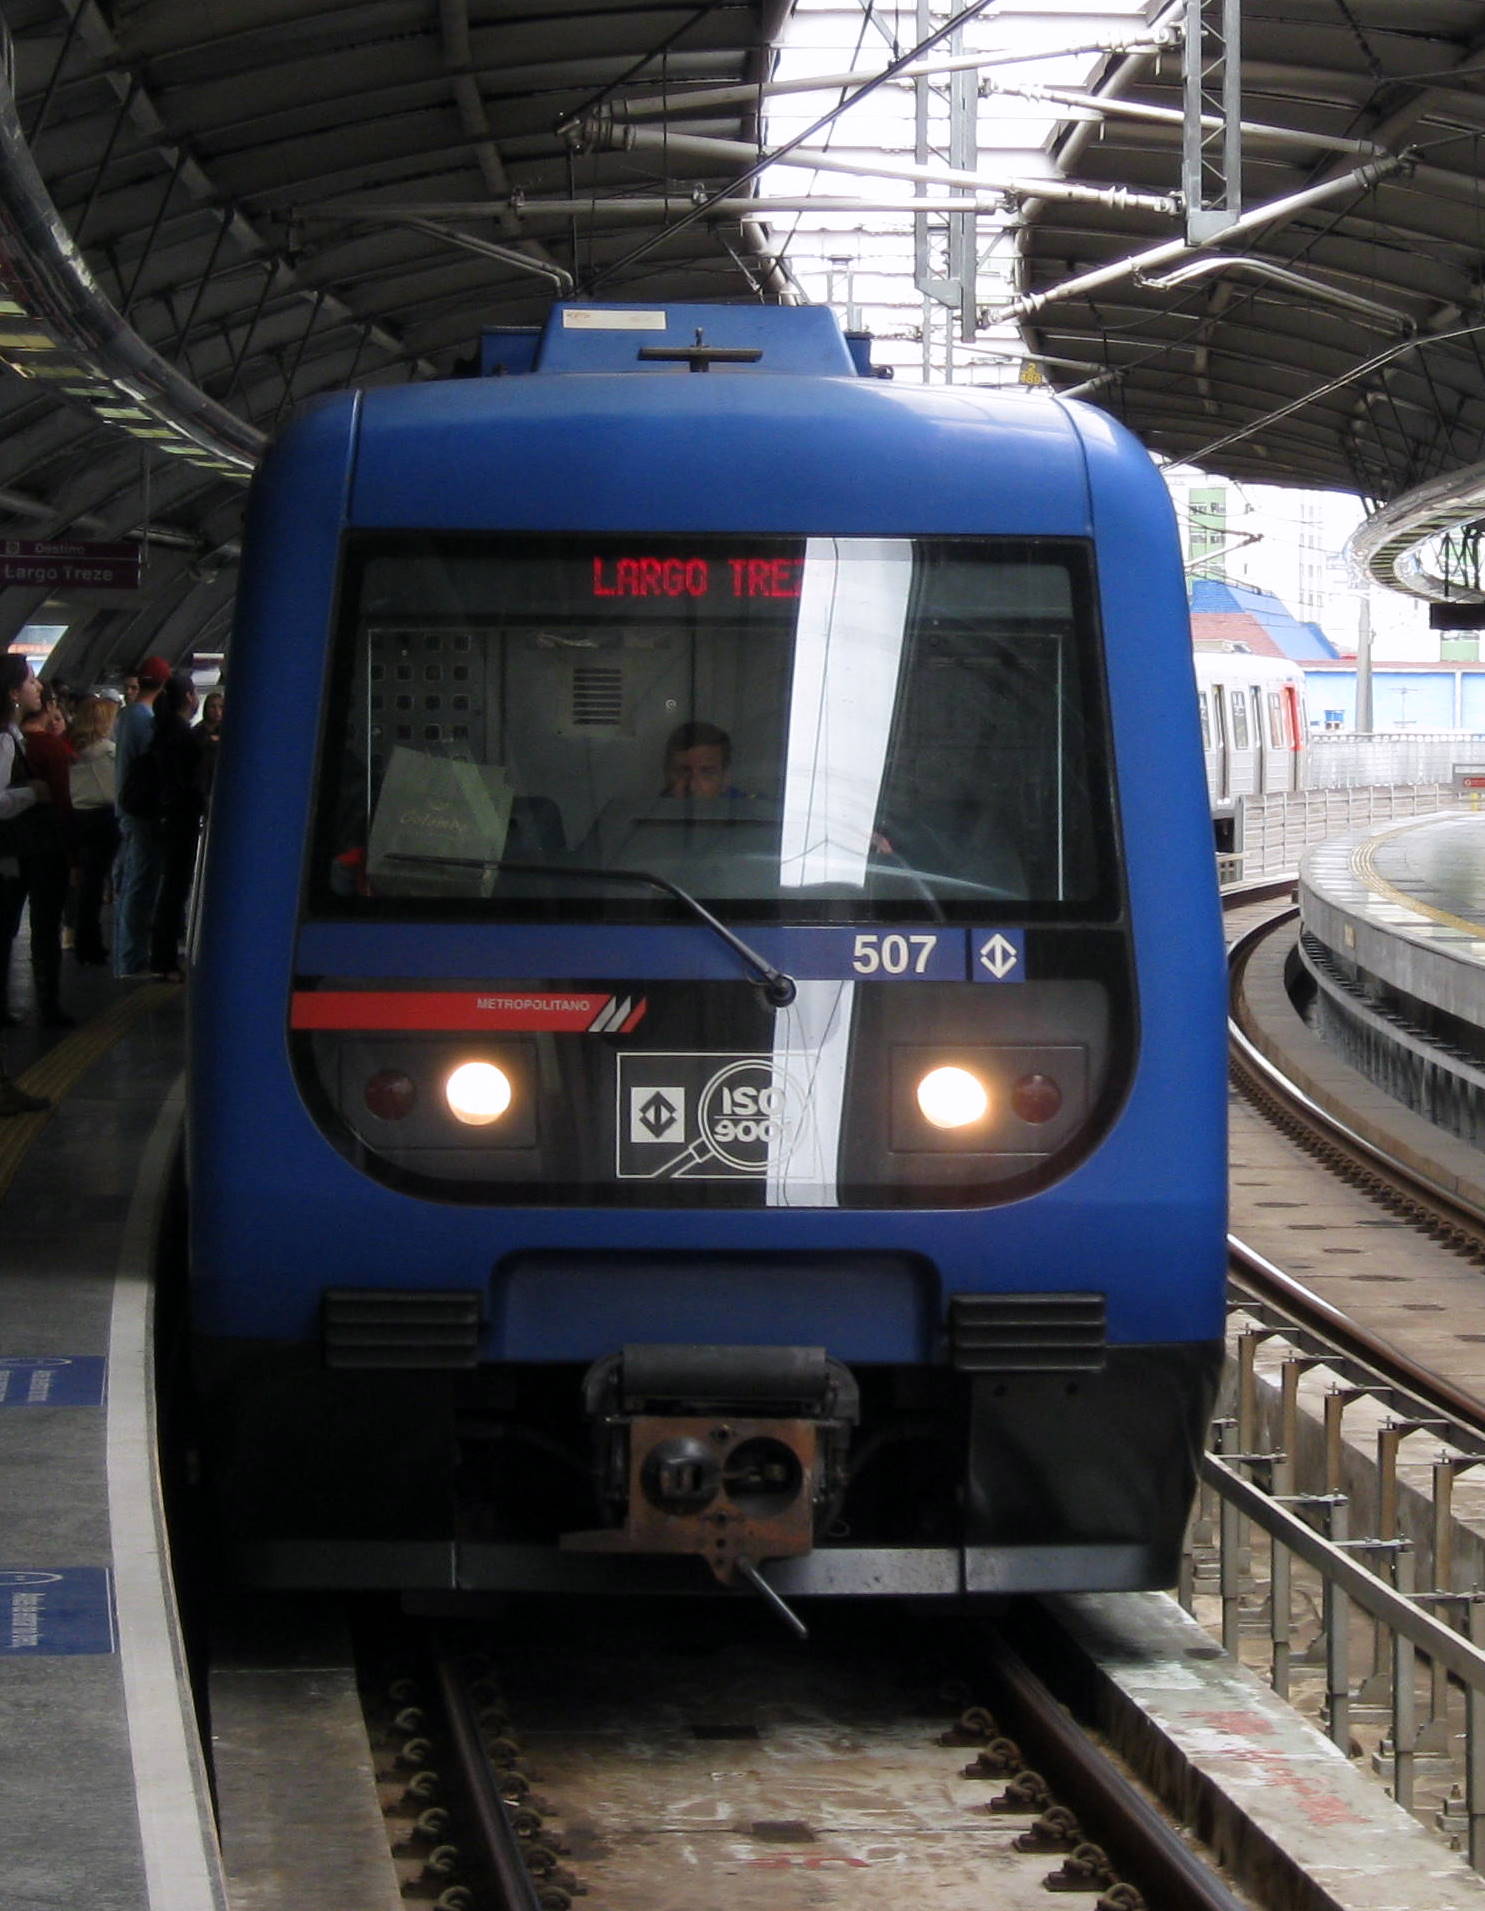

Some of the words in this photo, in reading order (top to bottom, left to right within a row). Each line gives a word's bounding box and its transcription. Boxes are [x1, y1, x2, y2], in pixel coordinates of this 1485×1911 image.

[5, 564, 57, 582] Largo
[63, 565, 113, 582] Treze
[593, 556, 708, 596] LARGO
[852, 934, 937, 973] 507
[476, 998, 590, 1012] METROPOLITANO
[722, 1086, 785, 1115] ISO
